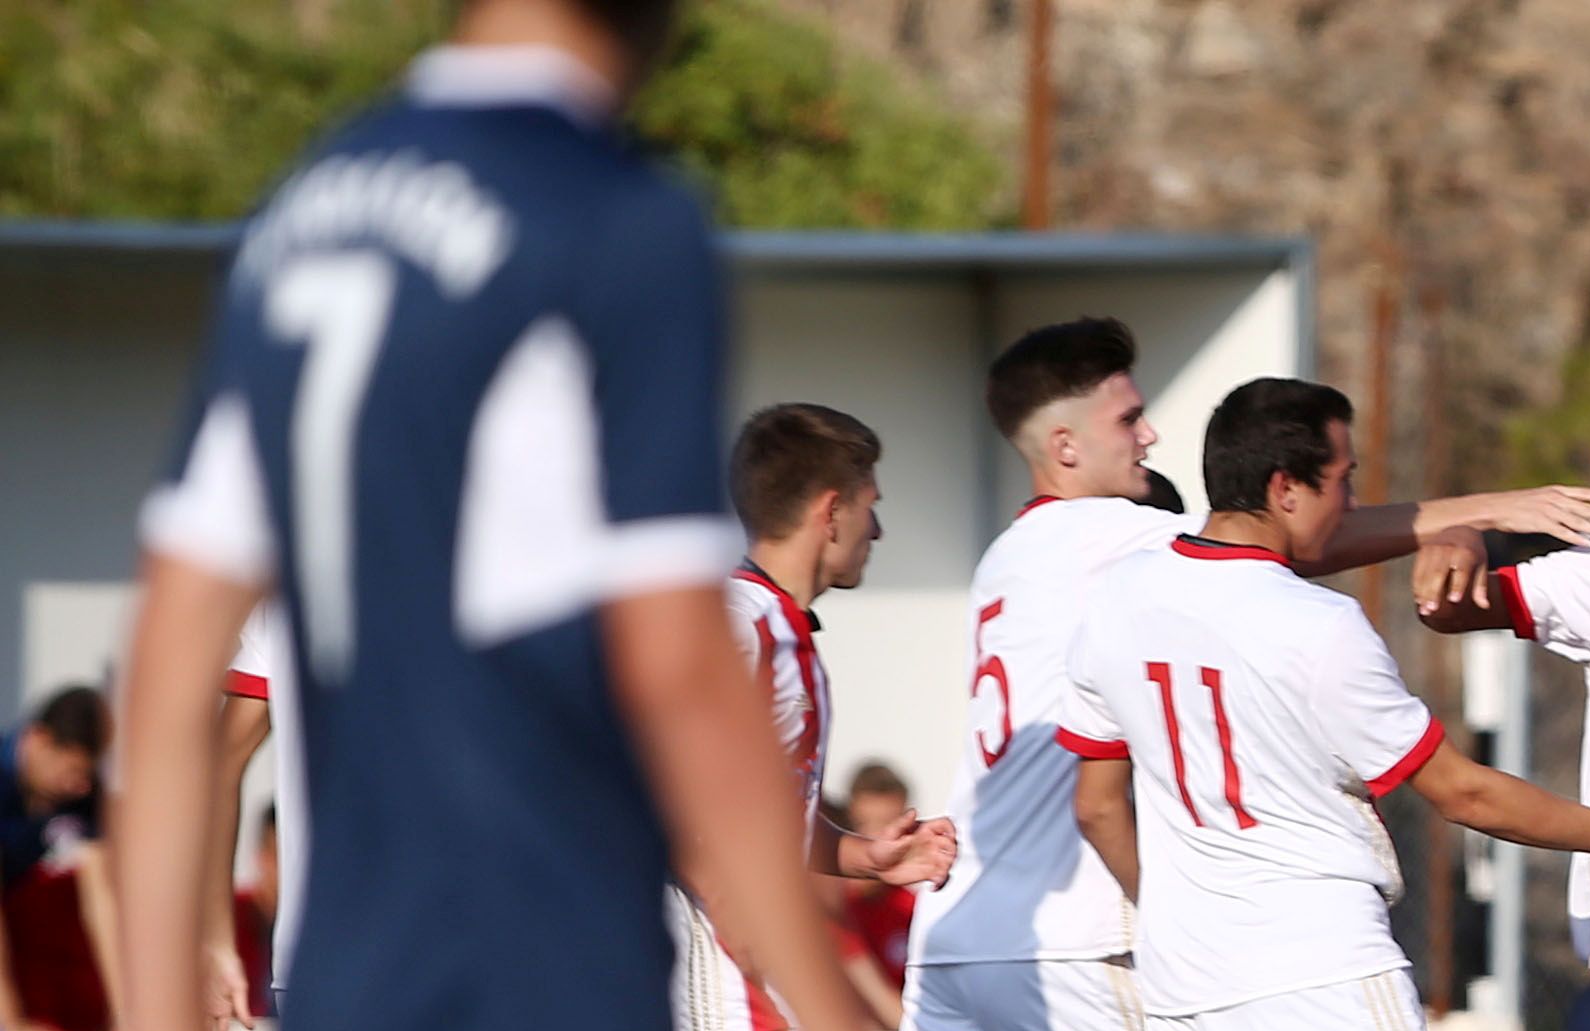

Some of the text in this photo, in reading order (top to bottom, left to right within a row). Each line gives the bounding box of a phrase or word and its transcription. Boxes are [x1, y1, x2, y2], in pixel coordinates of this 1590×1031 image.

[264, 250, 392, 684] 7
[971, 597, 1013, 768] 5
[1144, 660, 1258, 830] 11
